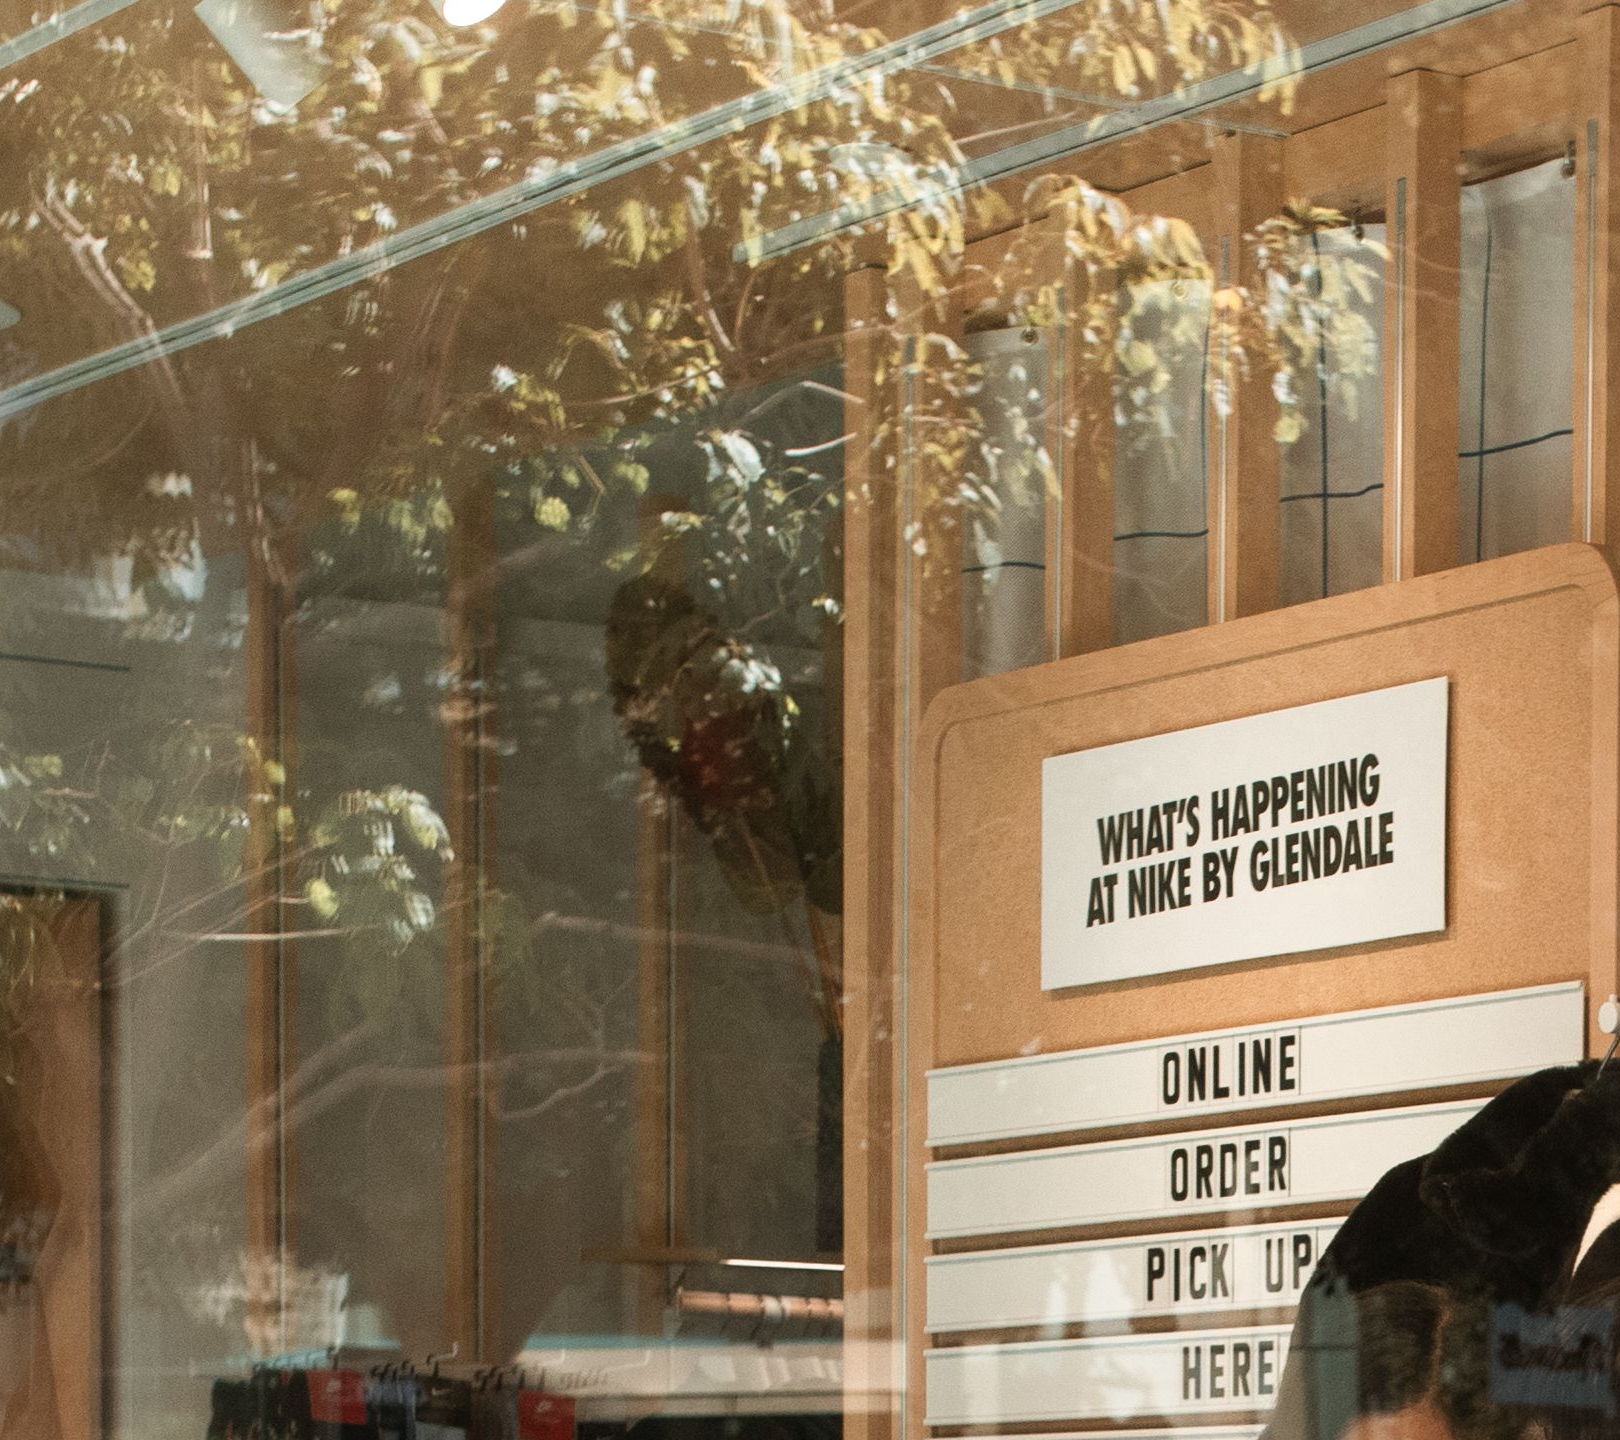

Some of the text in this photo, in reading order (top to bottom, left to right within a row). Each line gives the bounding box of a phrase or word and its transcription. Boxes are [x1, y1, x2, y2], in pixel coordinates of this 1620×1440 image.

[1097, 753, 1380, 866] WHAT'S HAPPENING
[1086, 811, 1394, 928] AT NIKE BY GLENDALE
[1163, 1034, 1295, 1105] ONLINE
[1171, 1135, 1287, 1202] ORDER
[1147, 1234, 1312, 1302] PICK UP
[1182, 1340, 1274, 1400] HERE
